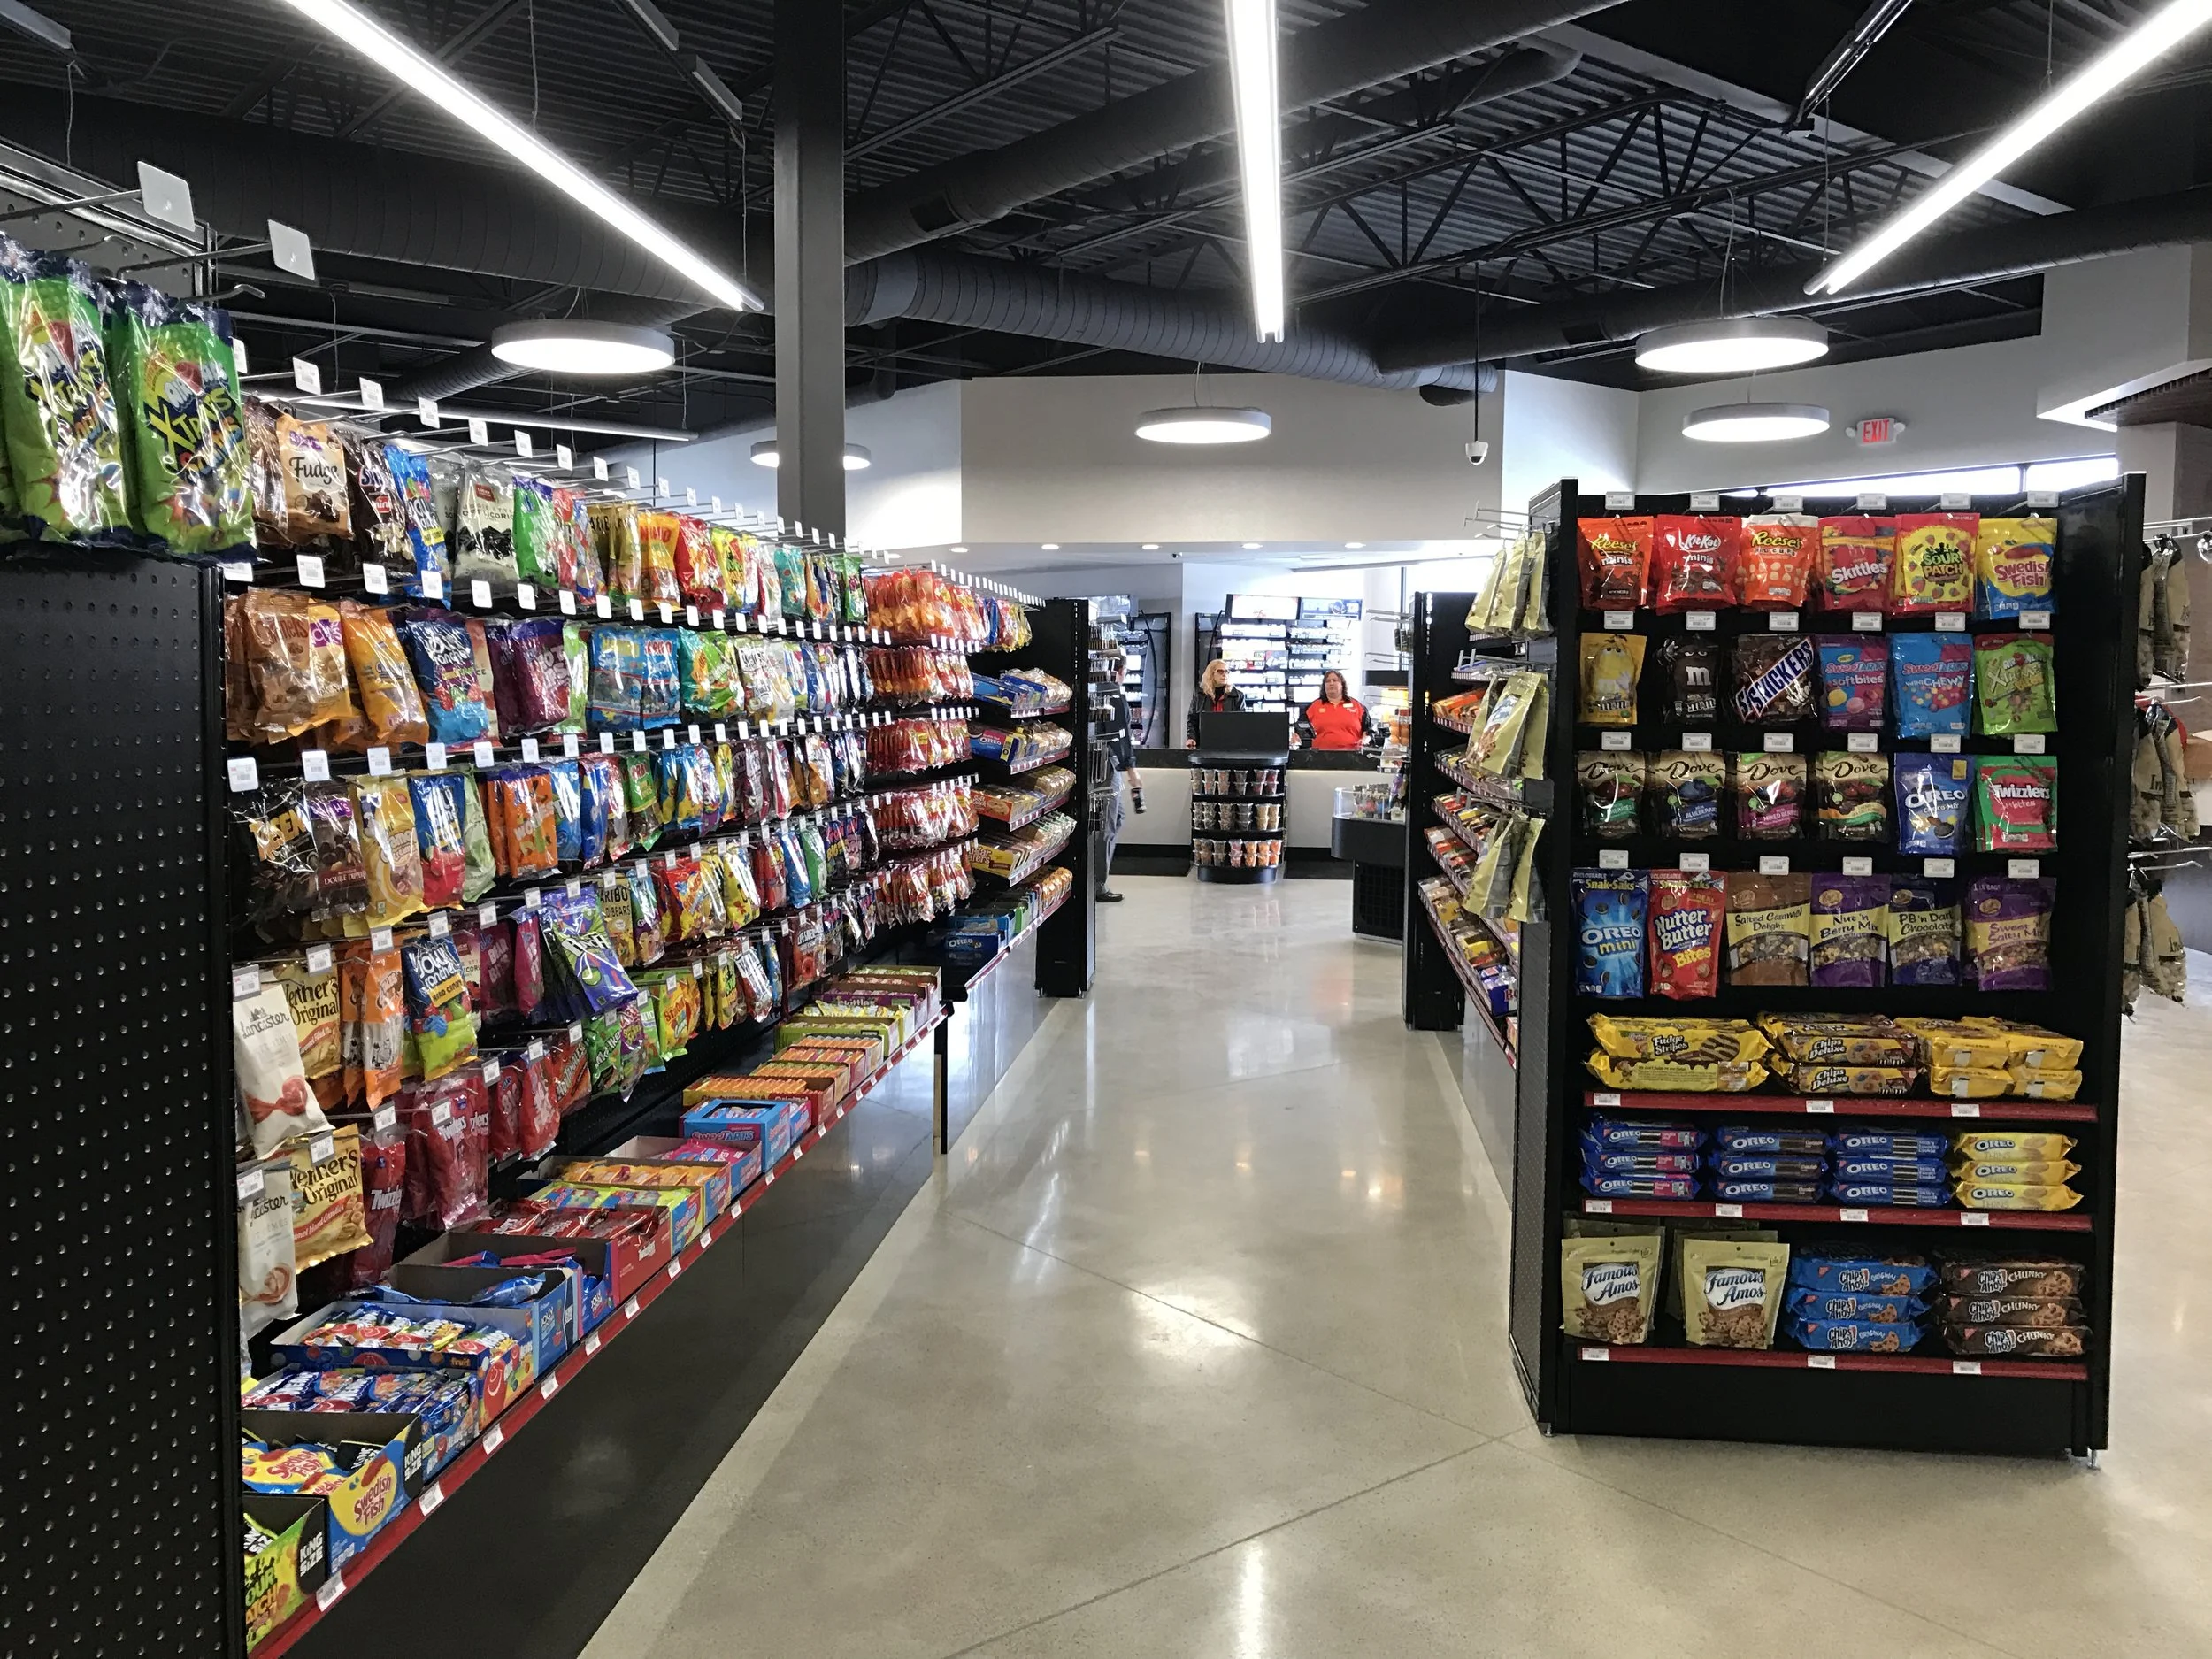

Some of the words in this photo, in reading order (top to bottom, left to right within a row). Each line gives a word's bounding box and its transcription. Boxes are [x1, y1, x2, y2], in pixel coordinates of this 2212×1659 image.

[1862, 418, 1890, 443] EXIT
[289, 456, 340, 485] Fudge
[1752, 531, 1803, 549] Reese's
[1601, 555, 1633, 566] minis
[1687, 554, 1714, 565] minis
[1923, 553, 1961, 565] SOUR
[1832, 561, 1887, 584] Skittles
[1924, 563, 1963, 577] PATCH
[2011, 574, 2046, 588] Fish
[1747, 641, 1814, 712] SNICKERS
[1924, 675, 1965, 687] CHEWY
[979, 737, 1002, 746] OREO
[1833, 760, 1882, 779] Dove
[1905, 789, 1965, 808] OREO
[1993, 784, 2050, 800] Twizzlers
[969, 845, 991, 858] ugar
[1586, 879, 1635, 891] Snak-Saks
[600, 886, 628, 903] ARIBO
[1655, 910, 1707, 936] Nutter
[1734, 915, 1764, 926] Salted
[1899, 914, 1916, 924] PB
[1582, 926, 1641, 945] OREO
[1661, 923, 1713, 951] Butter
[949, 938, 972, 948] OREO
[1599, 941, 1636, 955] mini
[1672, 947, 1712, 968] Bites
[289, 1001, 339, 1026] Original
[1652, 1034, 1684, 1046] Fudge
[1814, 1038, 1843, 1050] Chips
[1655, 1042, 1688, 1056] Stripes
[1809, 1045, 1846, 1060] Deluxe
[1816, 1068, 1845, 1080] Chips
[1812, 1075, 1848, 1091] Deluxe
[1609, 1130, 1641, 1141] OREO
[1732, 1136, 1775, 1149] OREO
[1847, 1136, 1887, 1148] OREO
[1976, 1140, 2015, 1151] OREO
[1606, 1156, 1637, 1166] OREO
[1728, 1161, 1770, 1173] OREO
[1847, 1163, 1888, 1173] OREO
[1976, 1166, 2016, 1177] OREO
[303, 1172, 360, 1206] Original
[1601, 1180, 1633, 1191] OREO
[1725, 1184, 1769, 1195] OREO
[1847, 1187, 1887, 1197] OREO
[1972, 1188, 2014, 1199] OREO
[250, 1195, 289, 1227] caster
[1581, 1263, 1638, 1292] Famous
[1704, 1267, 1765, 1294] Famous
[1840, 1269, 1863, 1282] Chips
[1978, 1271, 2001, 1284] Chips
[2008, 1271, 2047, 1282] CHUNKY
[1594, 1279, 1639, 1302] Amos
[1717, 1286, 1765, 1306] Amos
[1827, 1298, 1851, 1311] Chips
[1969, 1301, 1994, 1315] Chips
[2001, 1302, 2040, 1313] CHUNKY
[1828, 1326, 1852, 1340] Chips
[1985, 1331, 2009, 1346] Chips
[2017, 1331, 2055, 1343] CHUNKY
[450, 1357, 471, 1366] fruit
[404, 1442, 423, 1469] KING
[290, 1459, 324, 1478] Fish
[404, 1458, 423, 1481] SIZE
[354, 1474, 392, 1523] Swedish
[363, 1494, 385, 1525] Fish
[300, 1532, 323, 1563] KING
[300, 1548, 324, 1577] SIZE
[246, 1568, 277, 1607] OUR
[246, 1582, 278, 1623] ATCH
